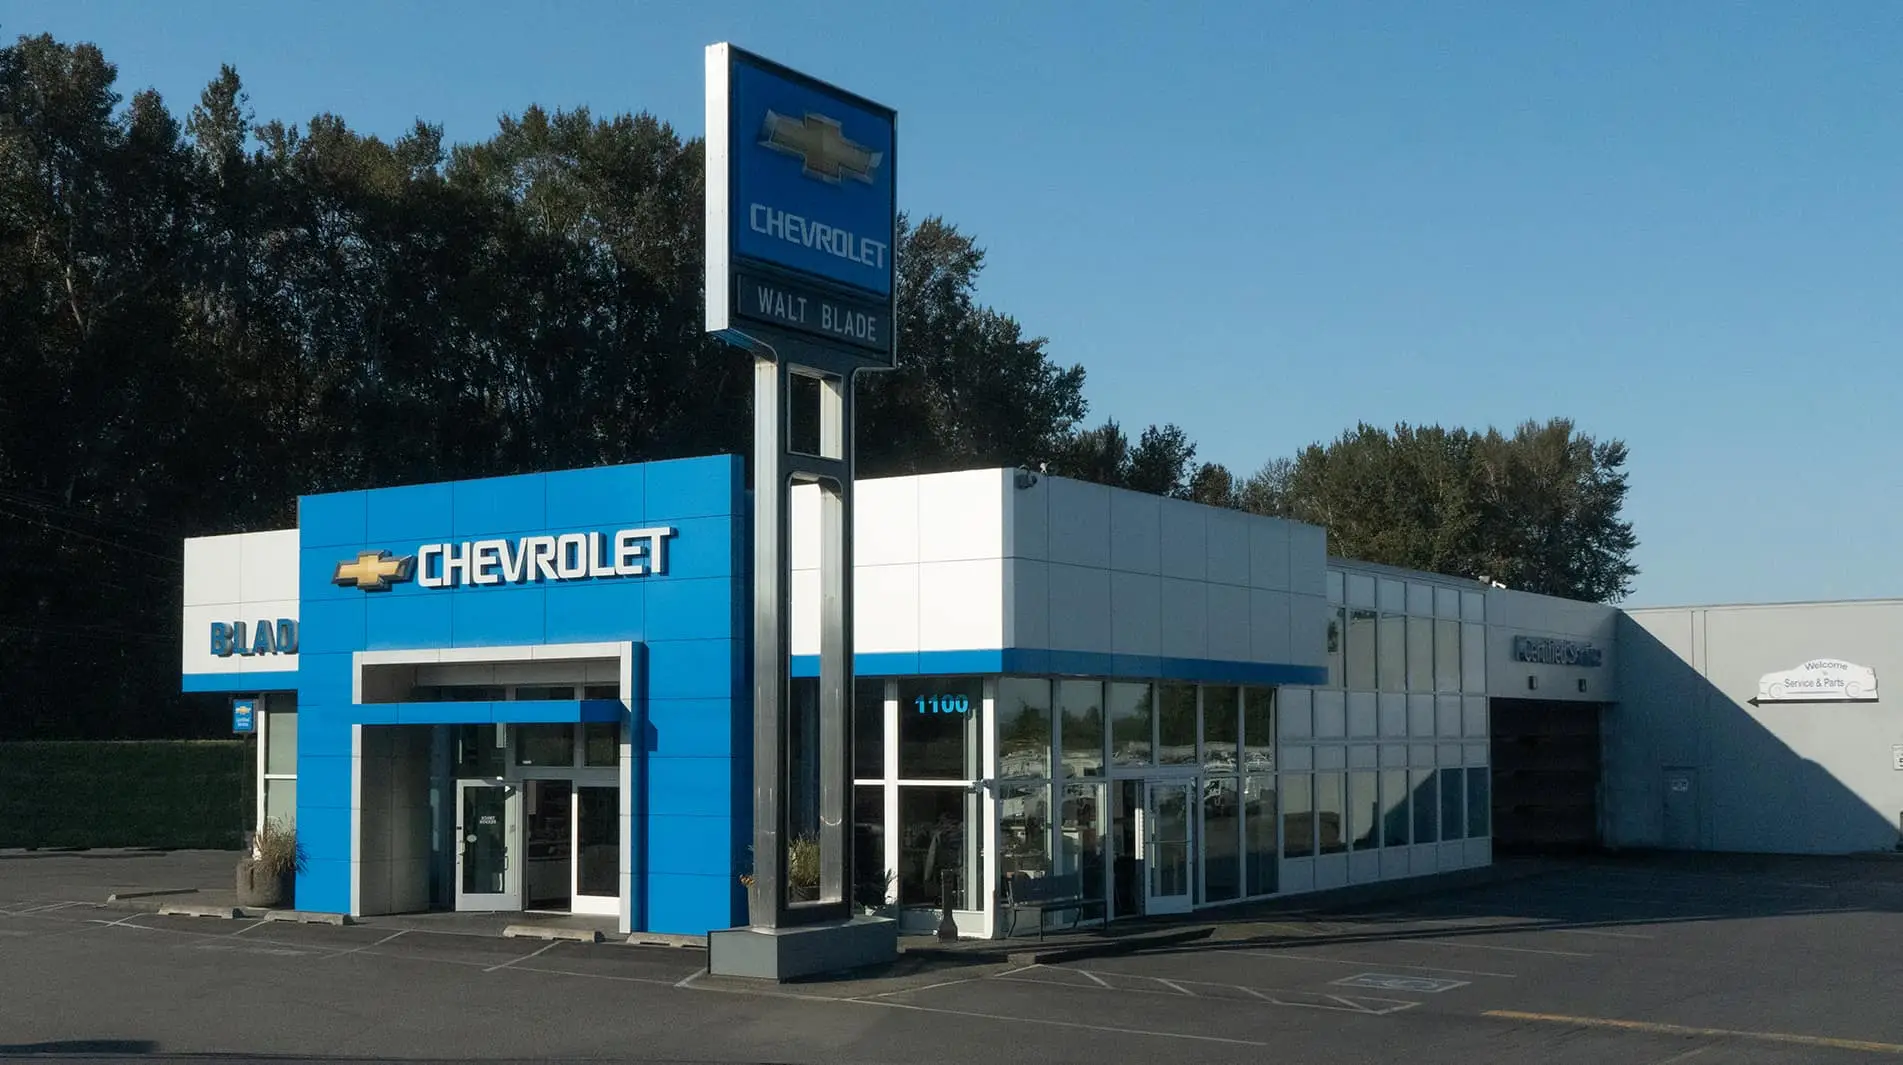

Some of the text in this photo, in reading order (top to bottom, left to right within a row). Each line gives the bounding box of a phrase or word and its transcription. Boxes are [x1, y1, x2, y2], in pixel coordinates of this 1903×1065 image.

[750, 203, 887, 269] CHEVROLET
[757, 285, 877, 342] WALT BLADE
[417, 526, 671, 587] CHEVROLET
[1784, 678, 1845, 688] Service & Parts
[1804, 661, 1848, 671] Welcome
[914, 694, 969, 714] 1100
